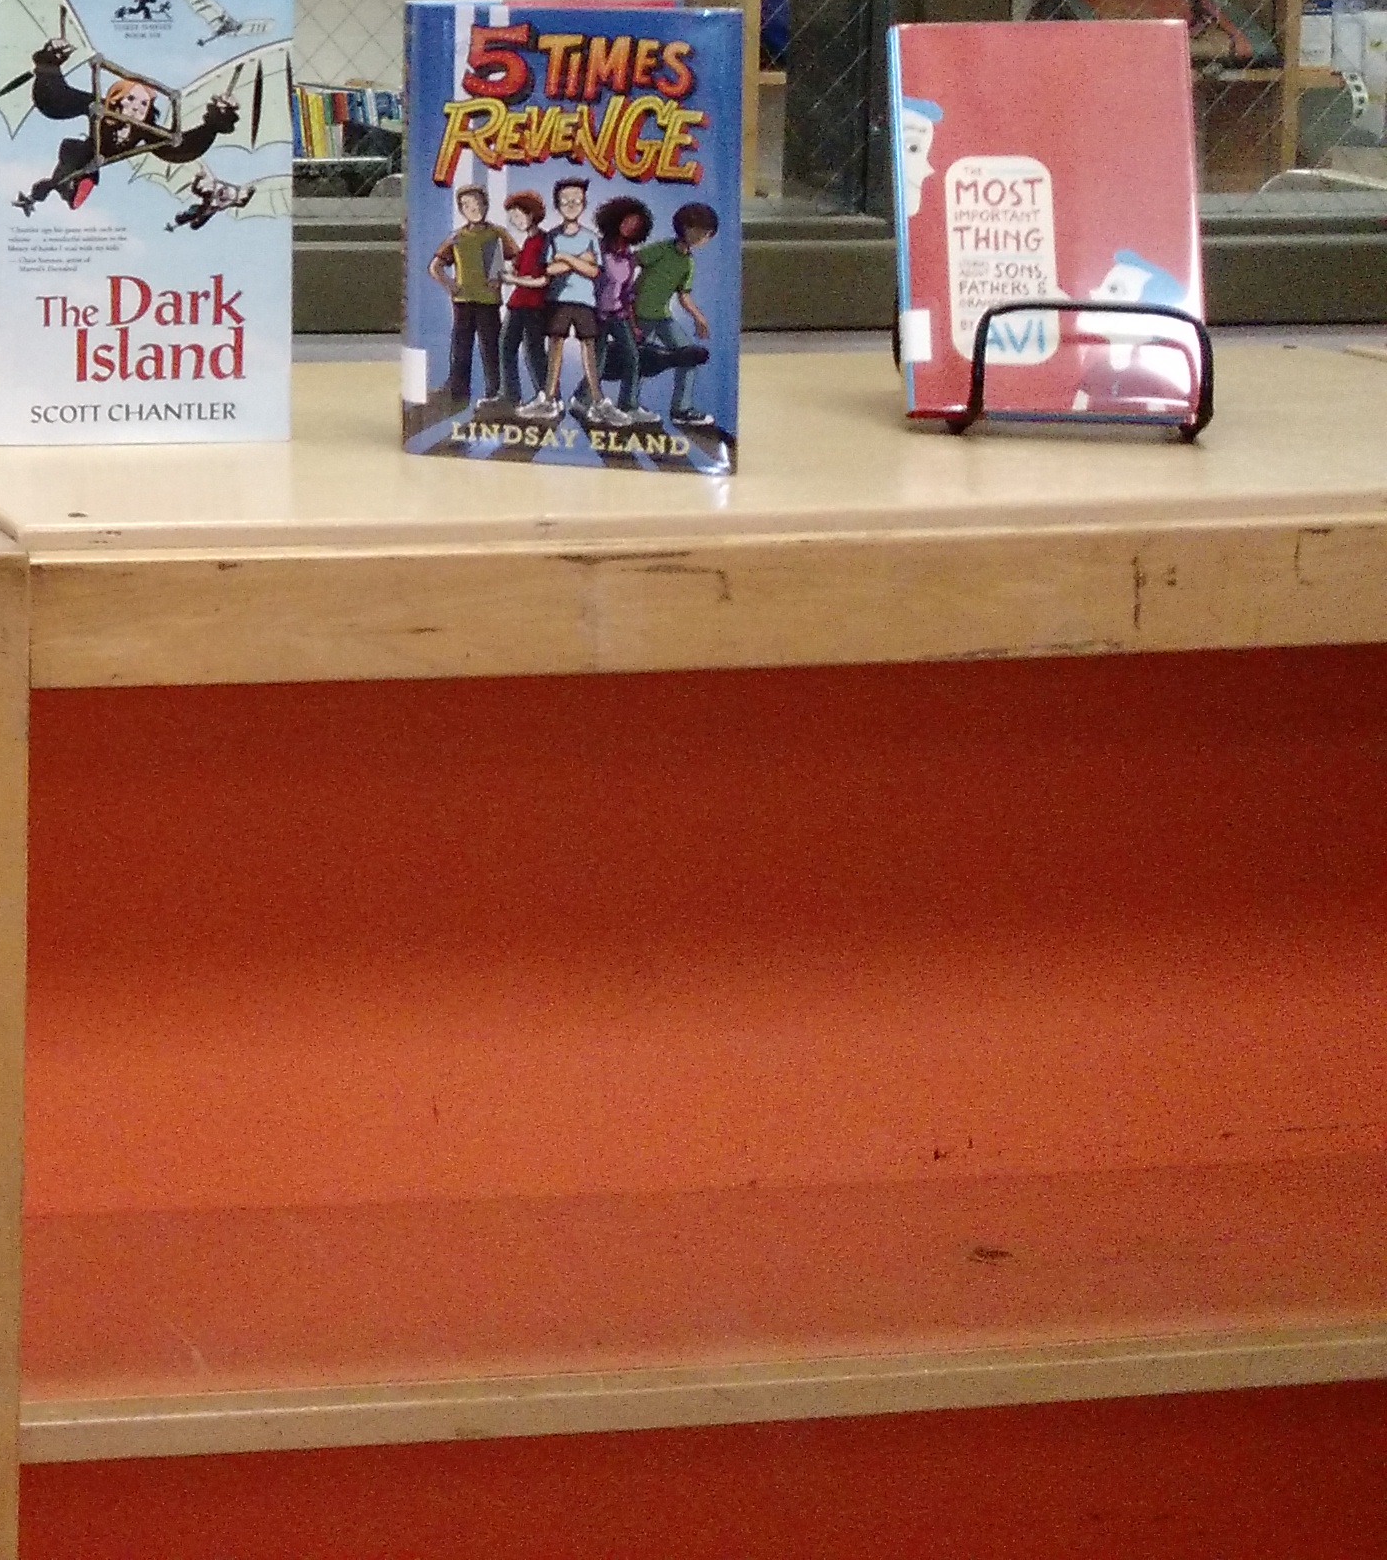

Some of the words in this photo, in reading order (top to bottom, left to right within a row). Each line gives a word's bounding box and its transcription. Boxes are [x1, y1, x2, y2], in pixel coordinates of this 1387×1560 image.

[463, 24, 533, 102] 5
[433, 96, 710, 187] REVENGE
[955, 177, 1043, 206] MOST
[954, 209, 1041, 222] IMPORTANT
[953, 227, 1043, 252] THING
[995, 263, 1047, 280] SONS,
[36, 296, 99, 329] The
[106, 274, 246, 328] Dark
[959, 281, 1029, 295] FATHERS
[75, 327, 246, 383] Island
[30, 404, 101, 425] SCOTT
[108, 402, 237, 423] CHANTLER
[451, 421, 578, 449] LINDSAY
[589, 430, 690, 458] ELAND
